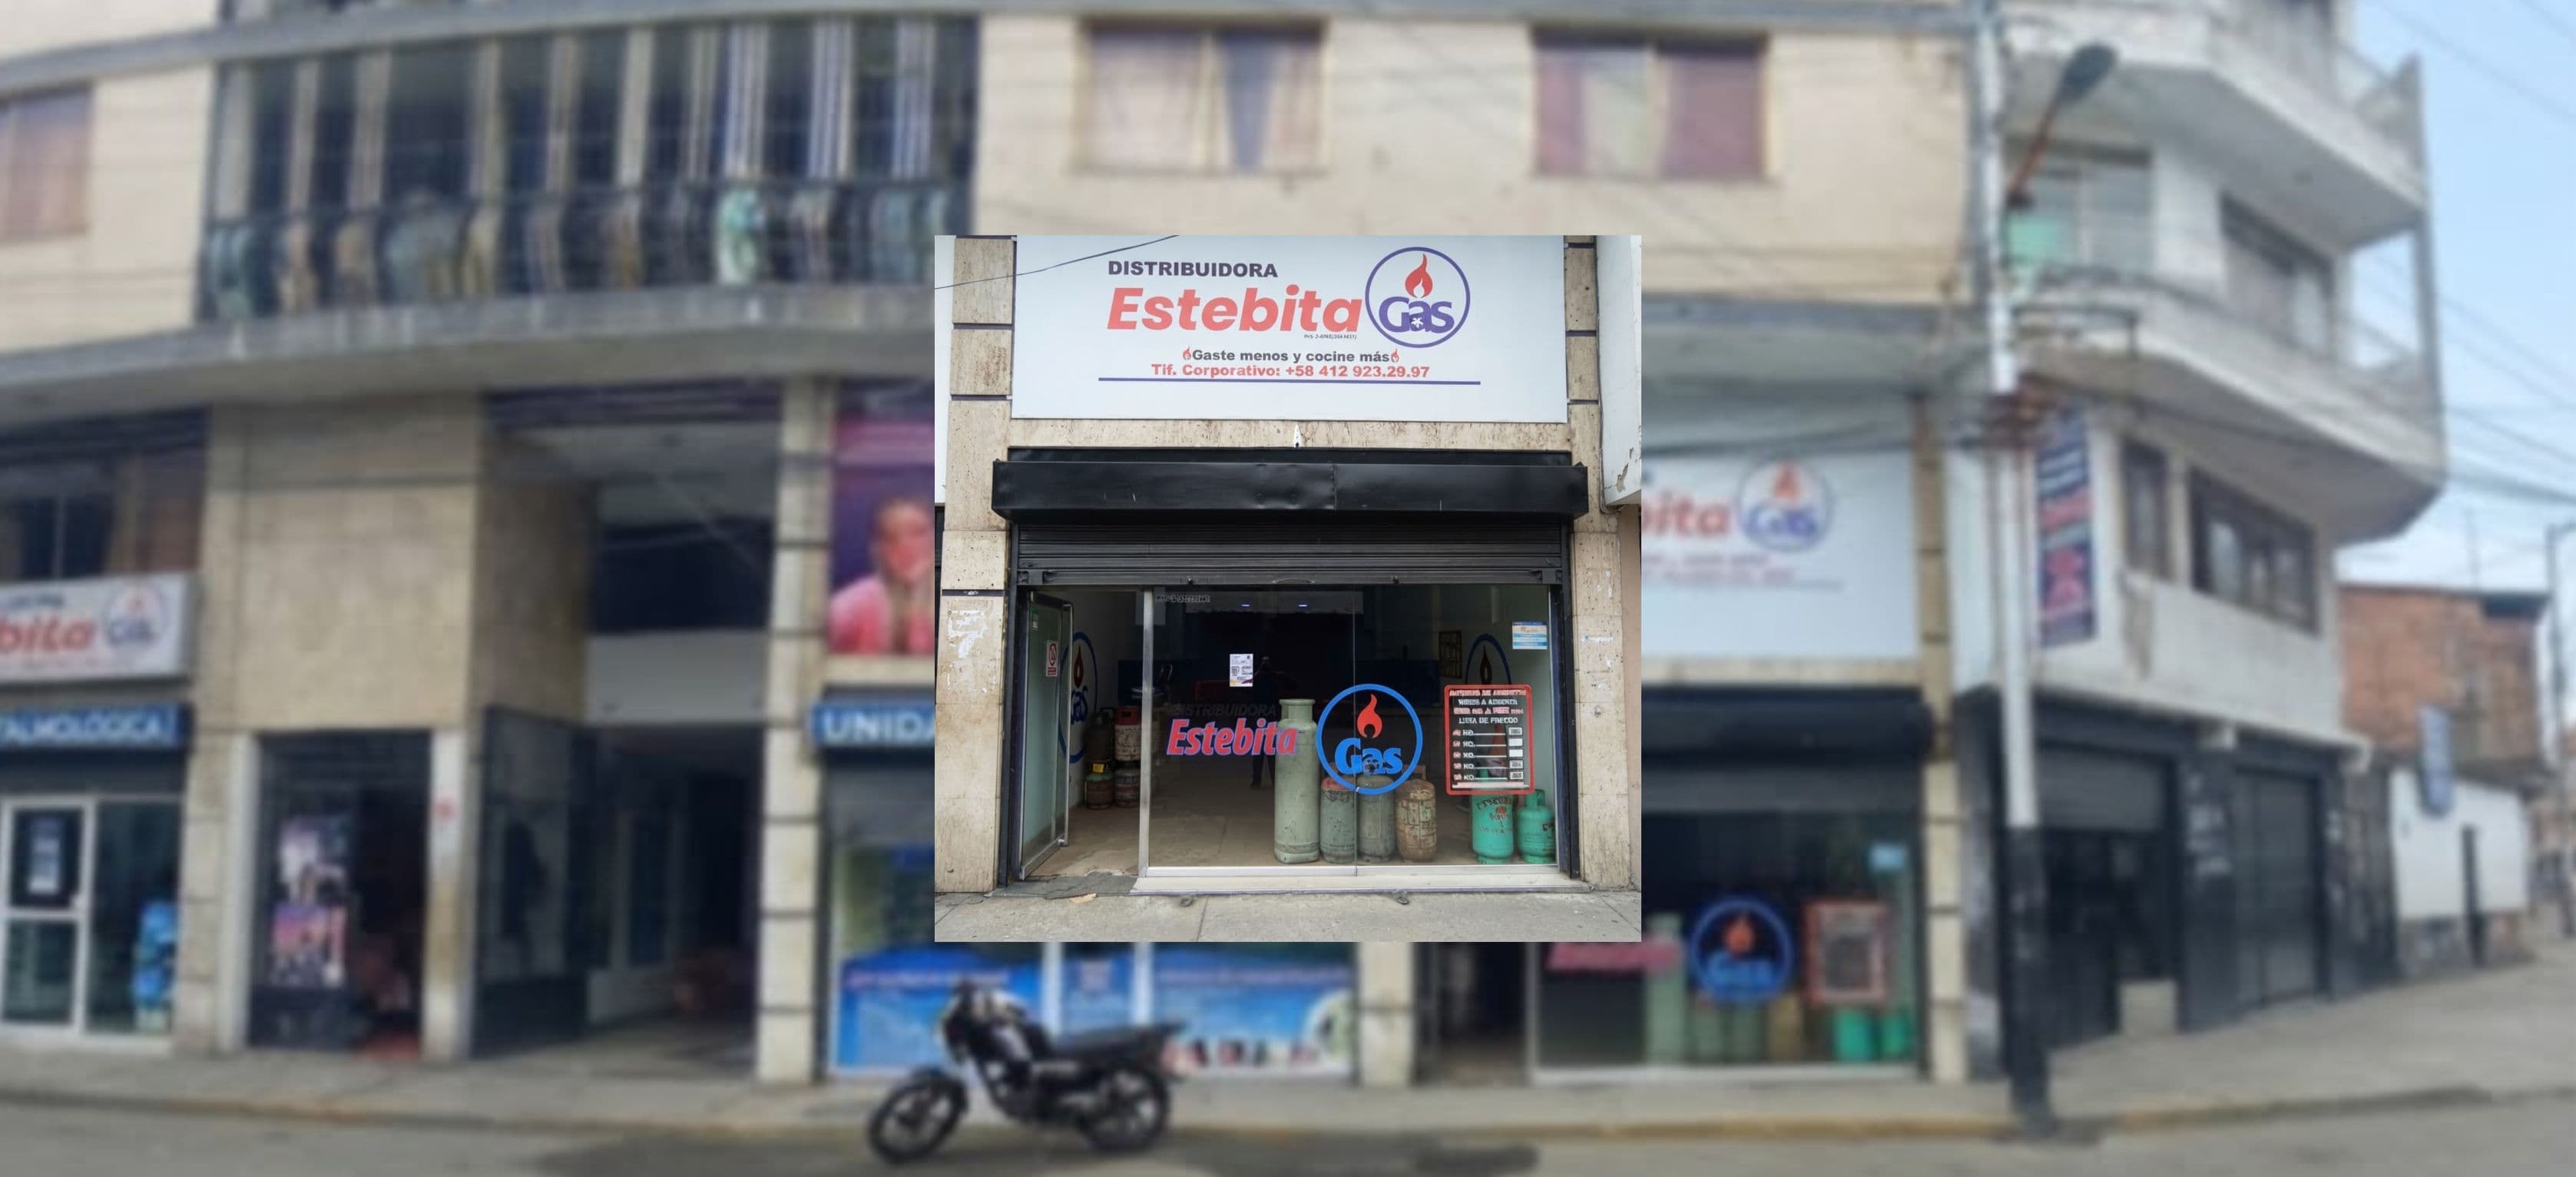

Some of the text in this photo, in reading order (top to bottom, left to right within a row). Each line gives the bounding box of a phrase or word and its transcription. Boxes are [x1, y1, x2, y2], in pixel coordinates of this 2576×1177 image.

[1109, 260, 1278, 277] DISTRIBUIDORA
[1107, 284, 1362, 332] Estebita
[1379, 296, 1455, 333] Gas
[1183, 364, 1280, 378] Corporativo:
[1286, 365, 1314, 376] +58
[1319, 366, 1348, 376] 412
[1353, 366, 1430, 377] 923.29.97
[1193, 350, 1389, 363] Gaste menos y cocine más
[1167, 718, 1299, 755] Estebita
[1335, 737, 1403, 774] Gas
